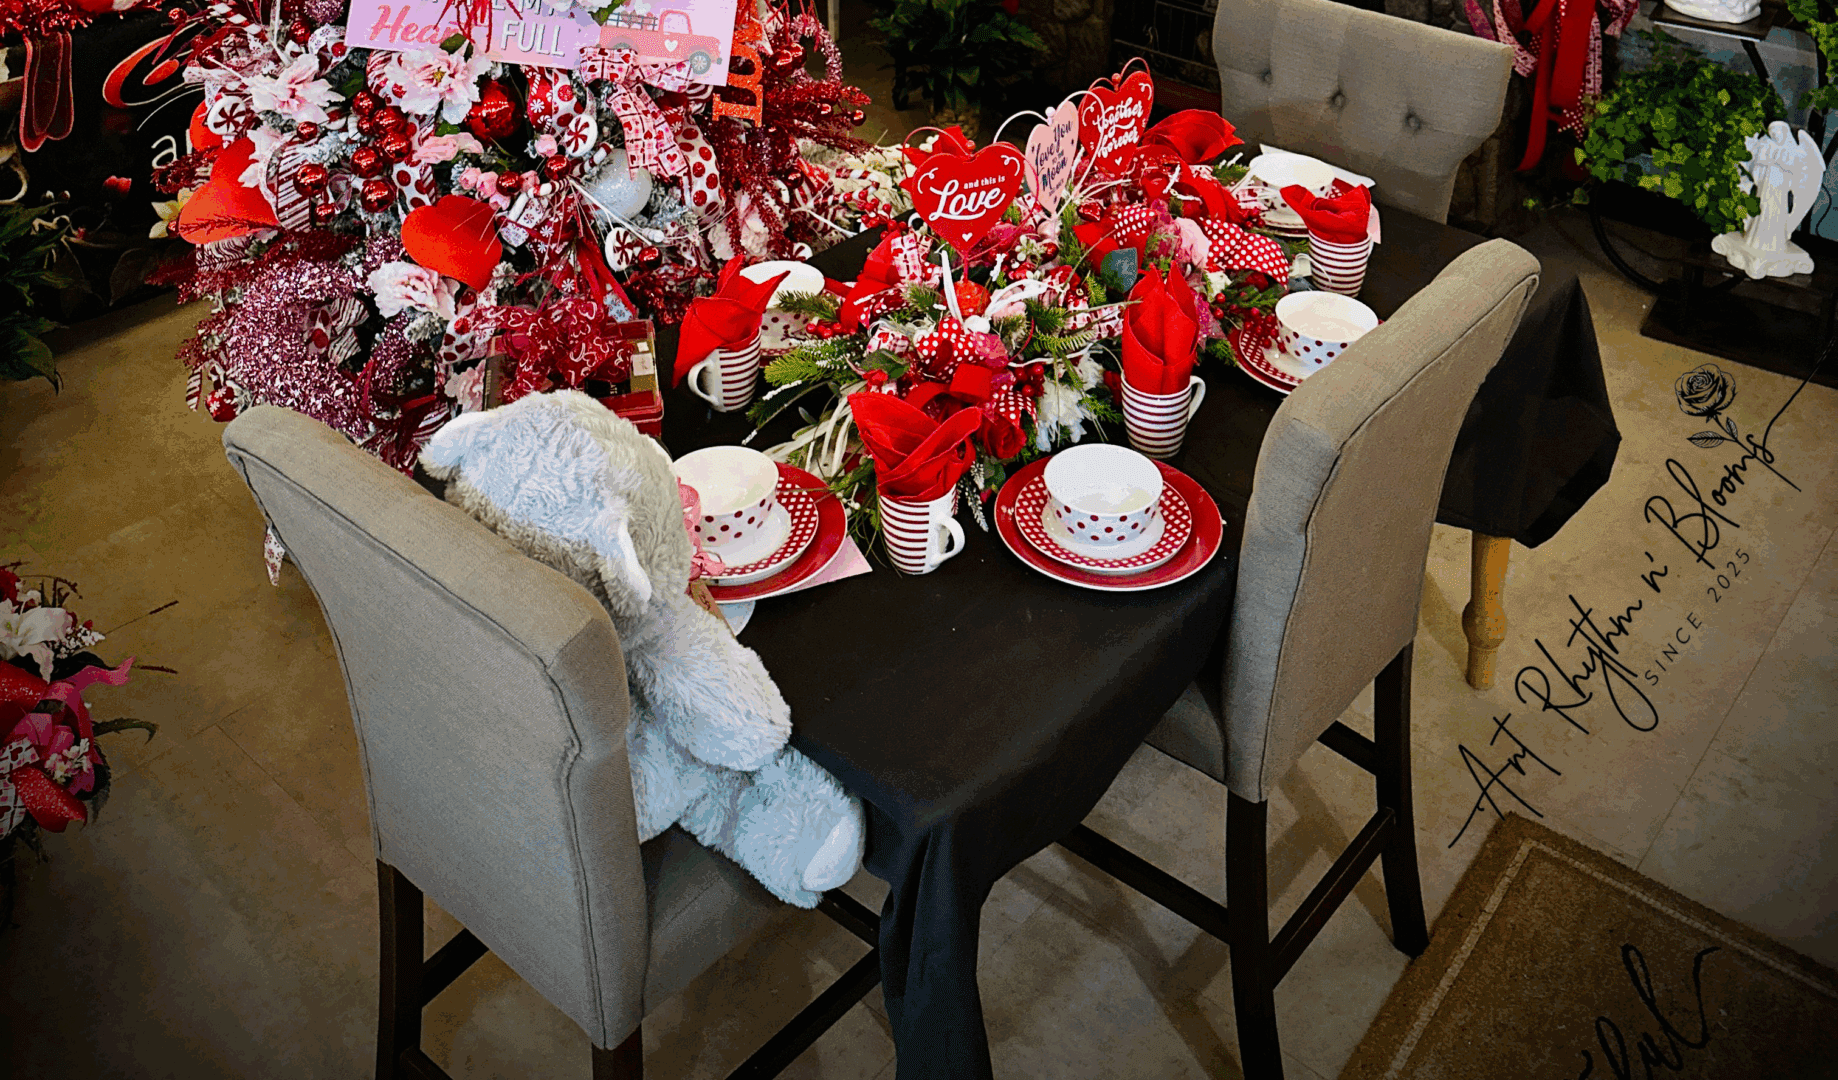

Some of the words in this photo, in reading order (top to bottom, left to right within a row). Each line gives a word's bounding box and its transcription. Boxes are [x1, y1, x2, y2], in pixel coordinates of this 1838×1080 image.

[369, 4, 488, 45] Hear
[500, 19, 566, 58] FULL
[1035, 142, 1055, 177] Love
[1053, 120, 1072, 153] You
[1097, 126, 1140, 159] forever
[963, 178, 980, 190] and
[980, 176, 997, 187] this
[997, 174, 1006, 183] is
[1041, 156, 1068, 192] Moon
[928, 179, 1007, 222] Love
